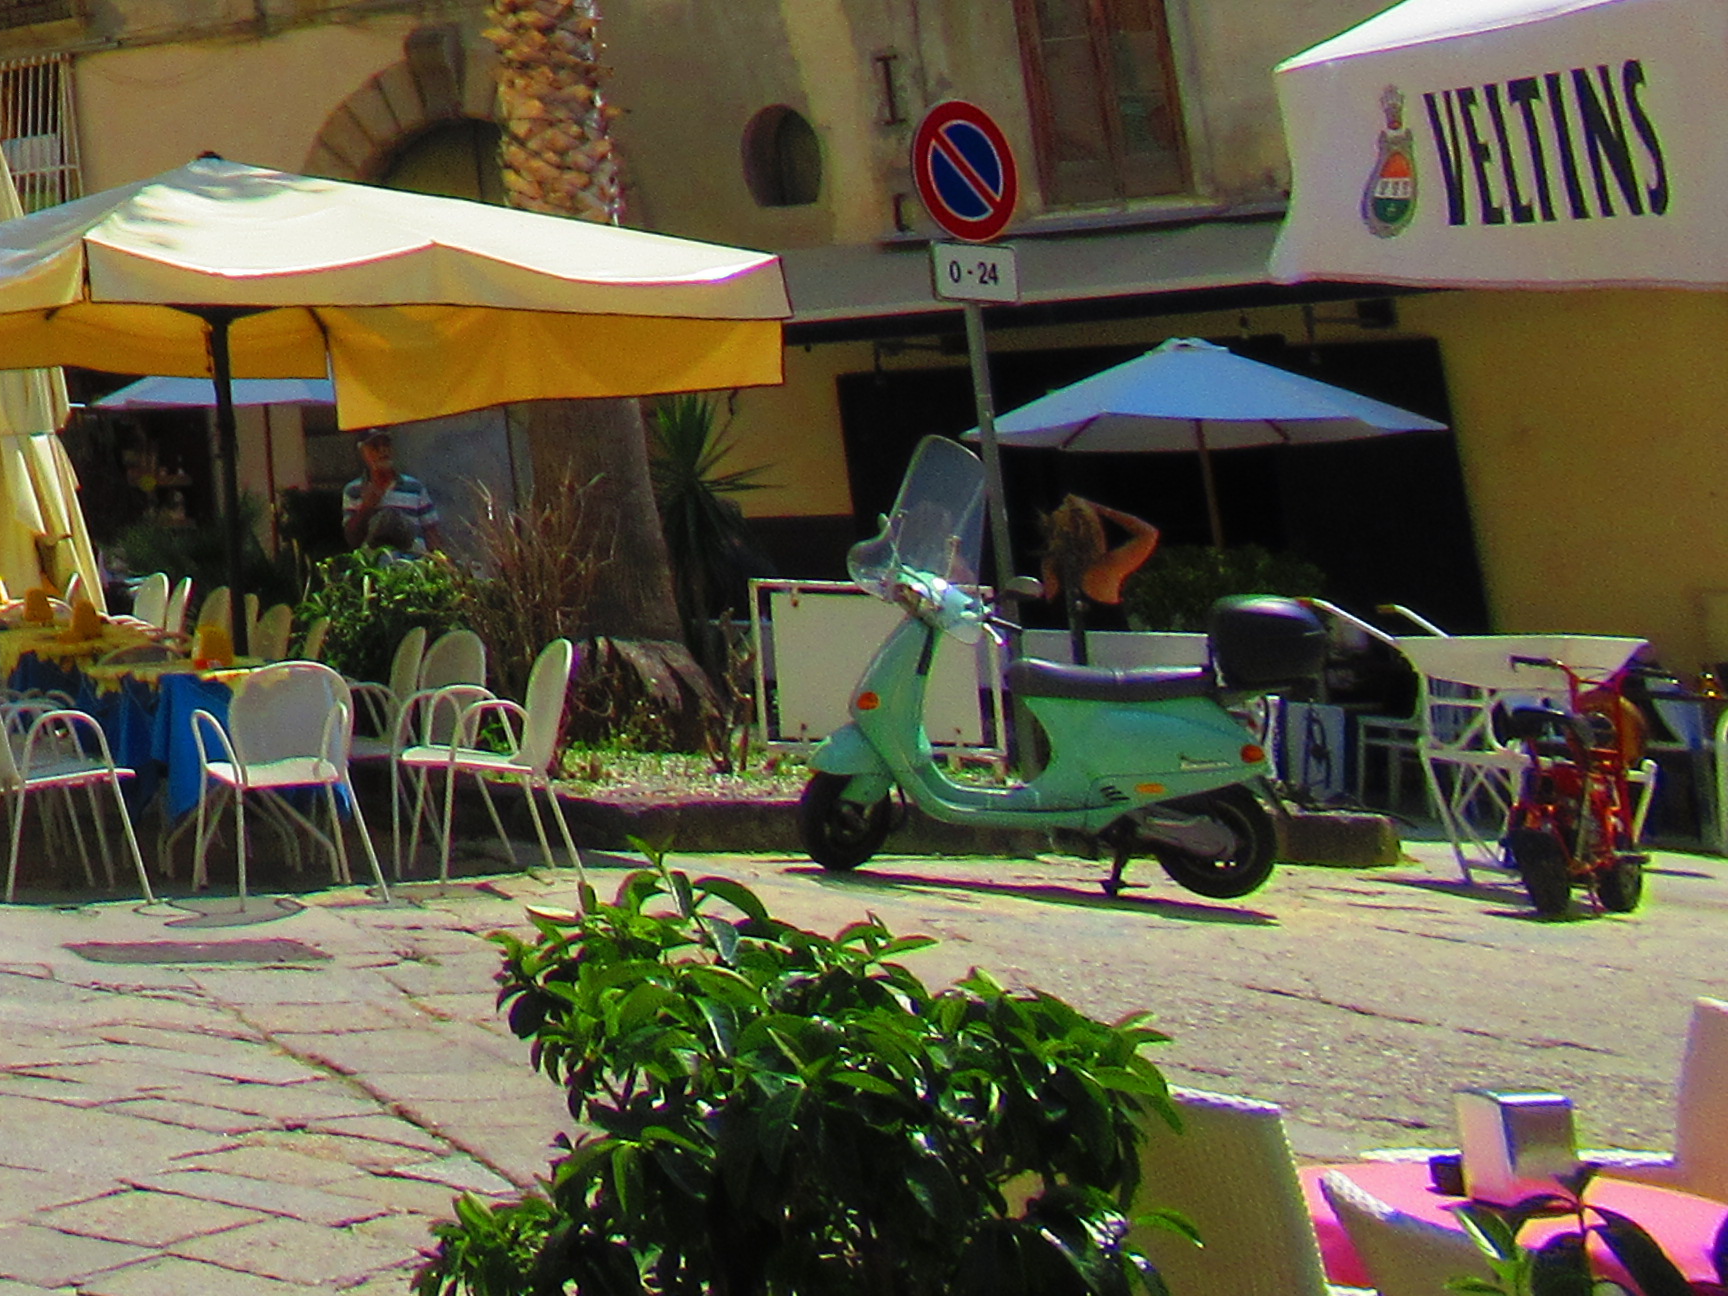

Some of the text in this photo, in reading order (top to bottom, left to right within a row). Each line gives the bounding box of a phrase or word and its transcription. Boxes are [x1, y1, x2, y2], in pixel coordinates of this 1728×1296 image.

[1422, 58, 1670, 227] VELTINS
[948, 259, 962, 284] 0
[976, 260, 1000, 286] 24
